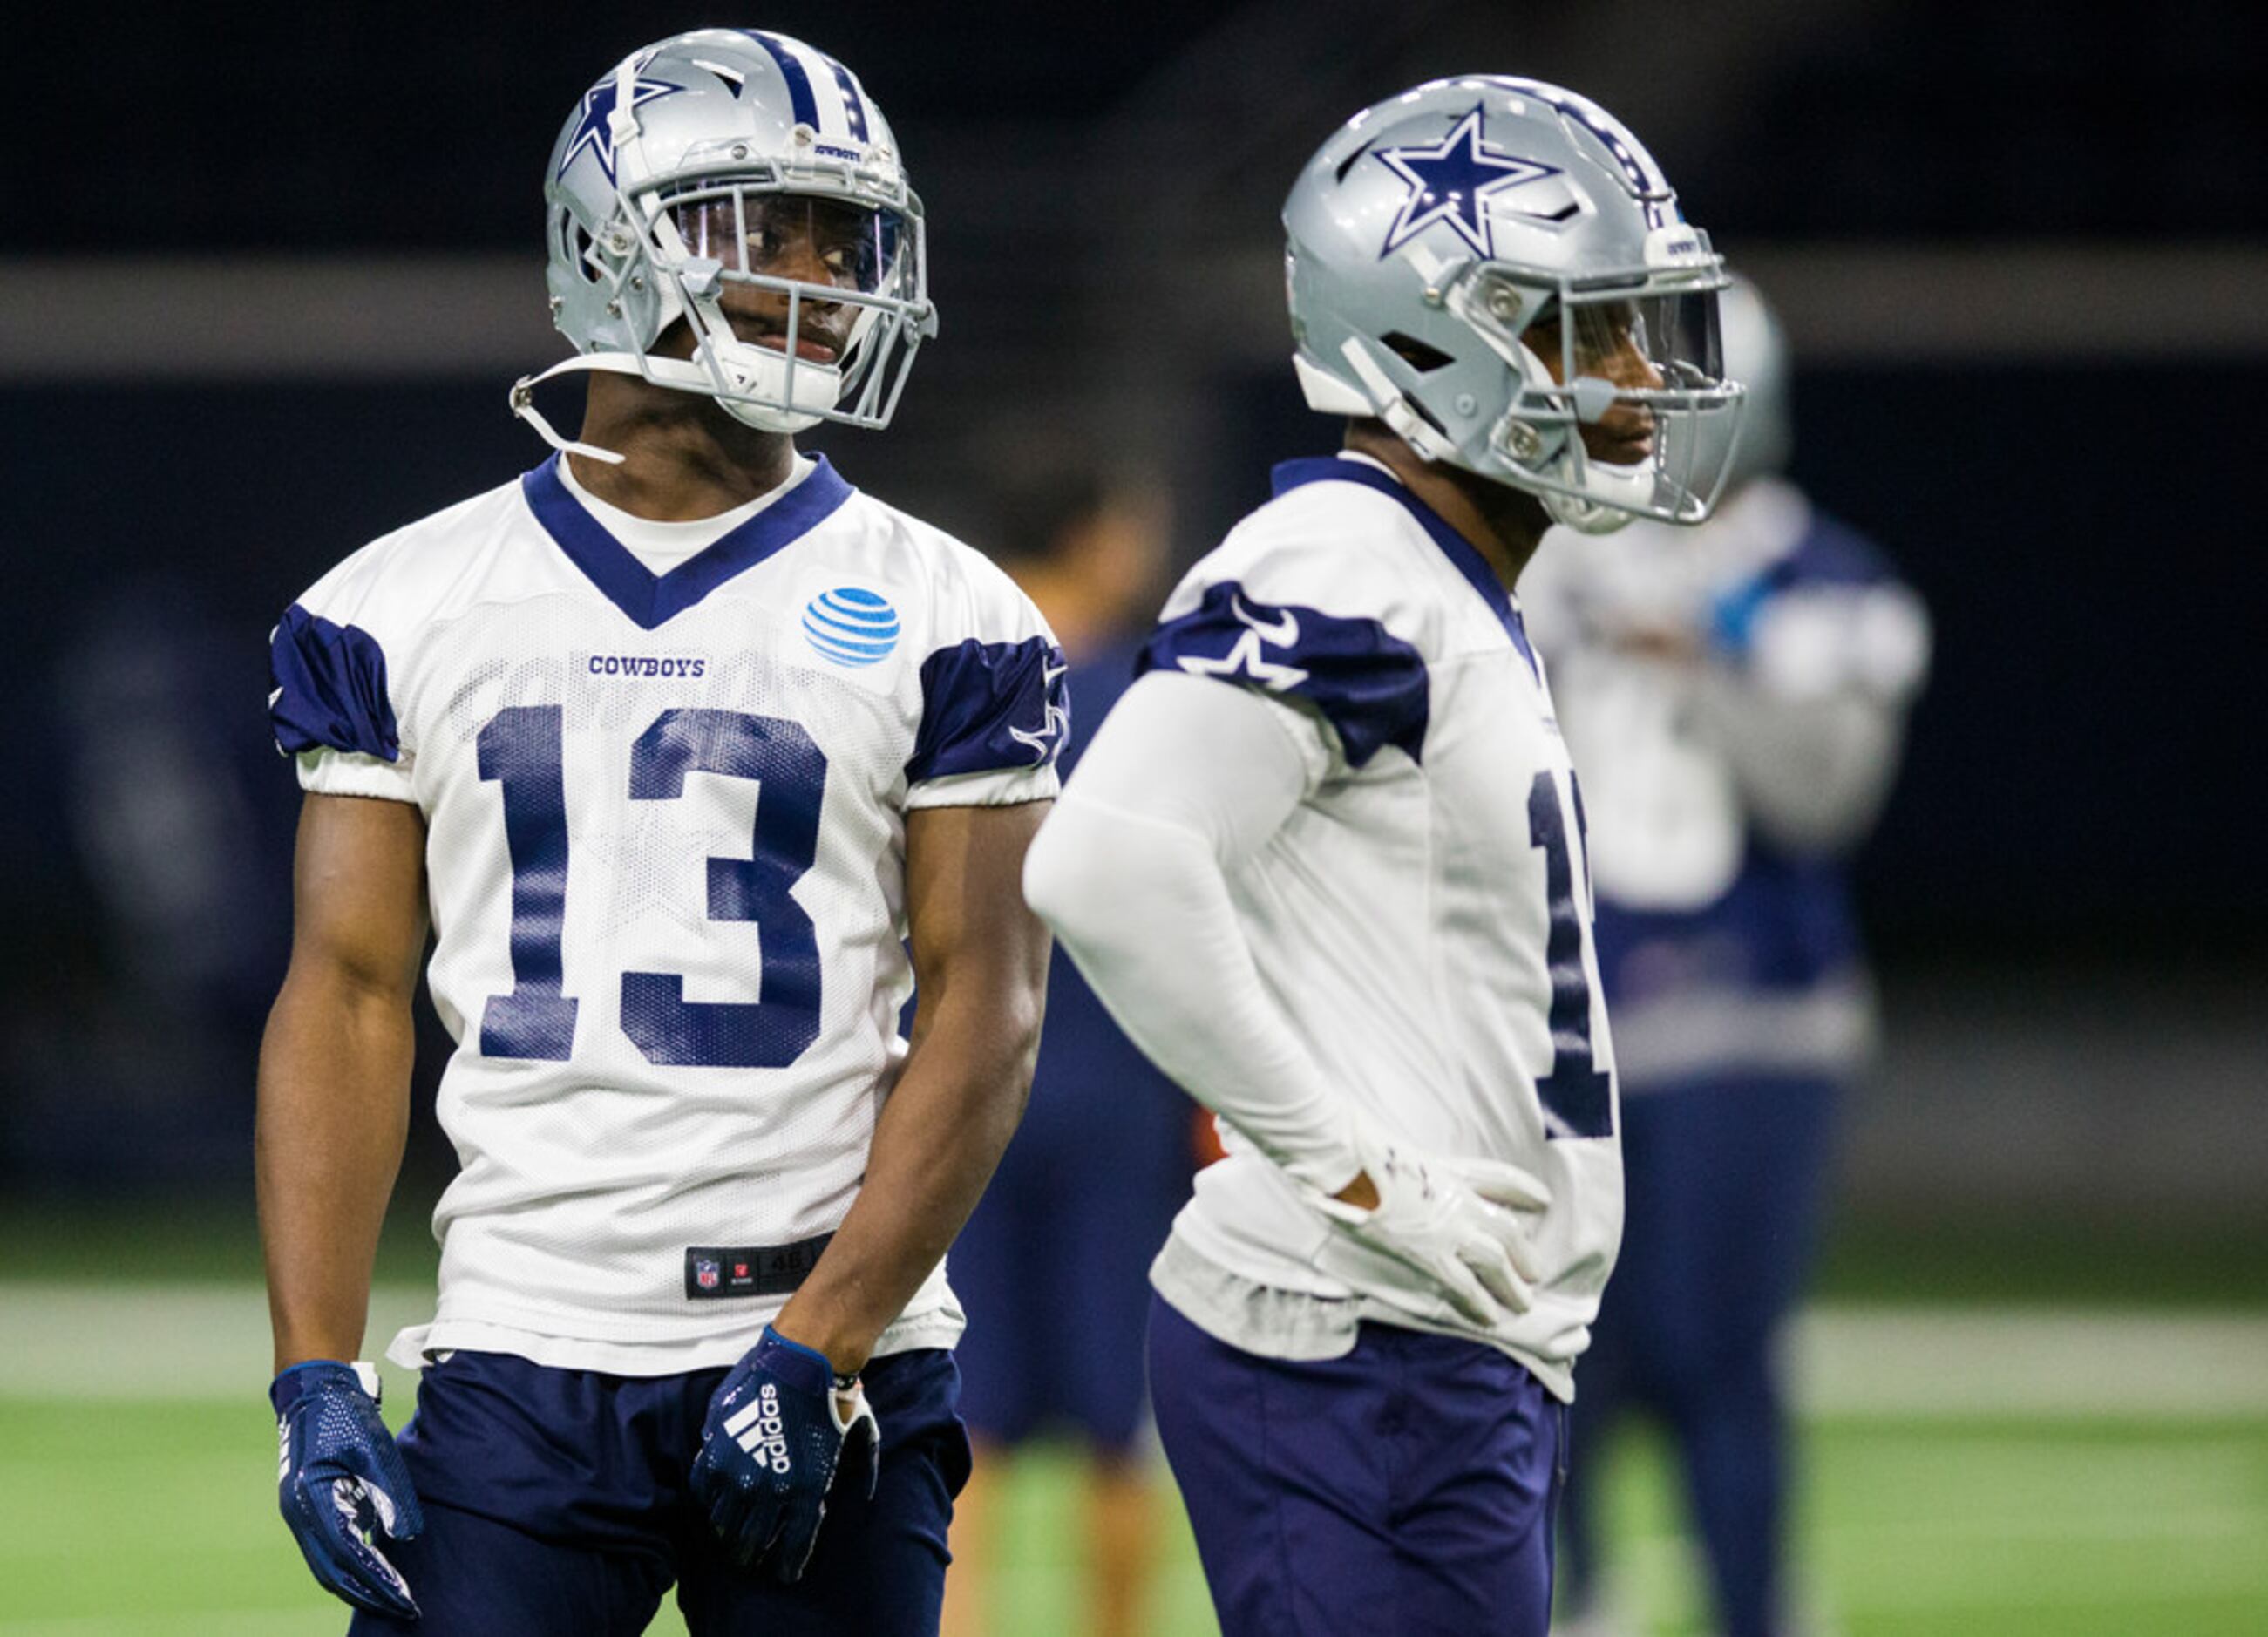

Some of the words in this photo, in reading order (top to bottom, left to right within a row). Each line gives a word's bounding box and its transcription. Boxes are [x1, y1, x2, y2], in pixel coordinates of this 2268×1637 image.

[589, 655, 705, 677] COWBOYS
[477, 704, 828, 1069] 13
[1528, 770, 1613, 1140] 1
[760, 1383, 791, 1474] adidas
